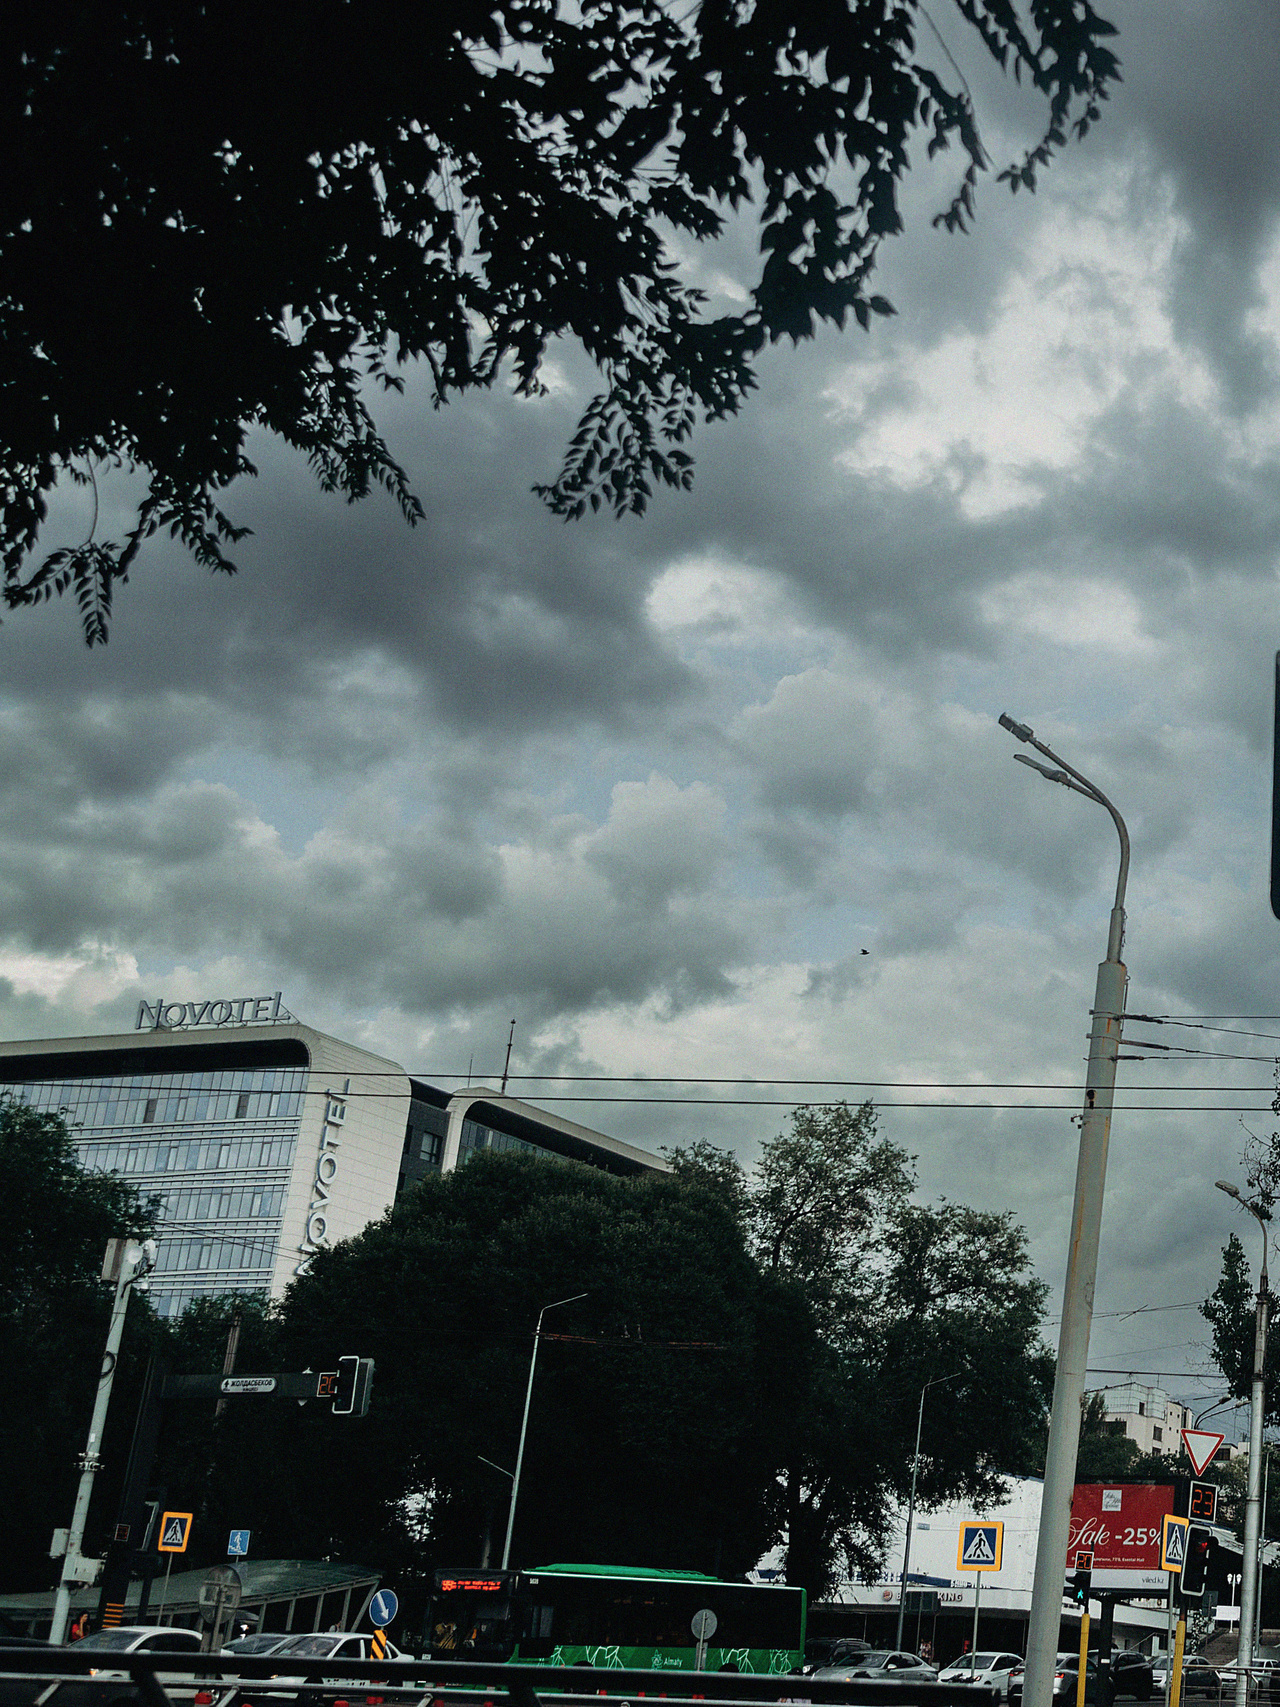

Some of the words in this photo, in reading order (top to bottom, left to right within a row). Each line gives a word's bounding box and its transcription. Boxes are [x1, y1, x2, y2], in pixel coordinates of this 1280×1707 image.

[135, 991, 290, 1029] NOVOTEL
[1191, 1489, 1214, 1516] 23
[1068, 1517, 1110, 1551] Sale
[1114, 1527, 1161, 1547] -25%
[1076, 1553, 1092, 1570] 20
